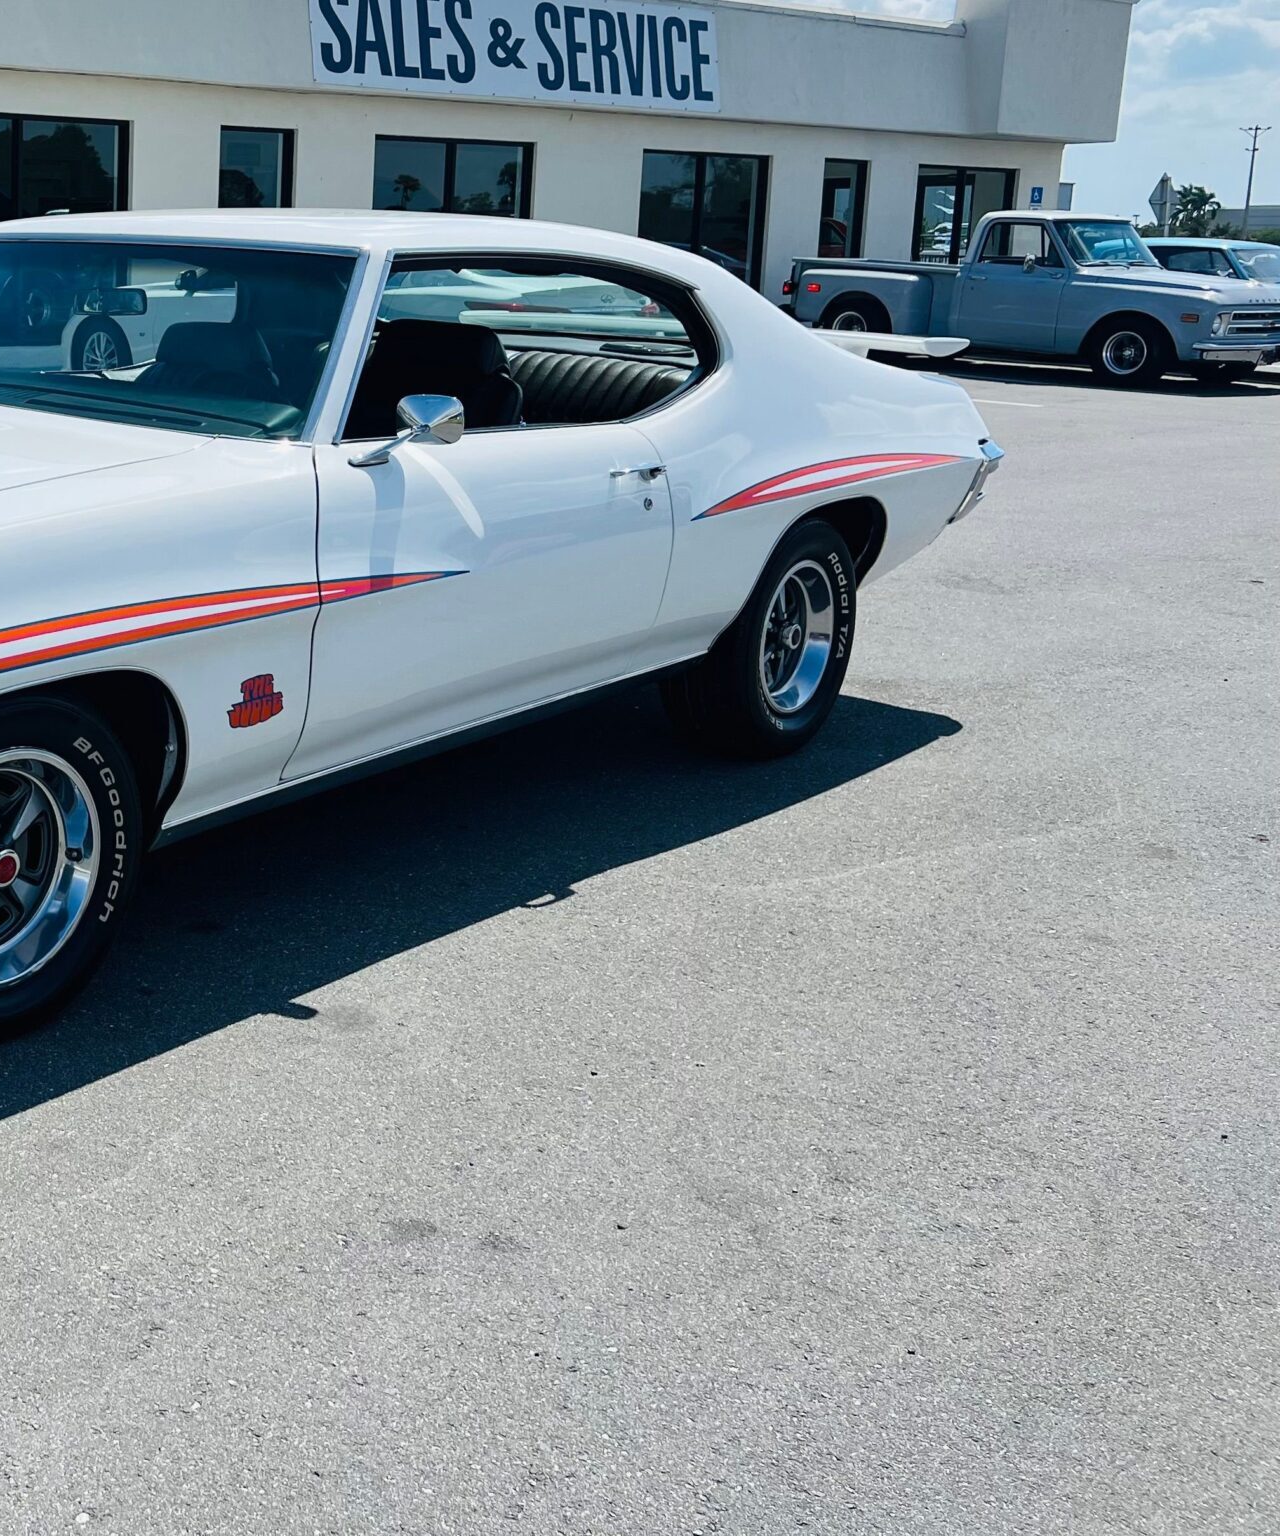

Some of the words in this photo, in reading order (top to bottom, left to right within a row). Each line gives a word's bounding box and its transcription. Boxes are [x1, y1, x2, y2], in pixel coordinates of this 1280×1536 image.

[318, 0, 476, 84] SALES
[487, 18, 528, 70] &
[534, 1, 714, 102] SERVICE
[828, 552, 849, 614] Radial
[835, 624, 849, 659] T/A
[226, 691, 284, 729] JUDGE
[240, 673, 275, 702] THE
[72, 736, 127, 923] BFGoodrich
